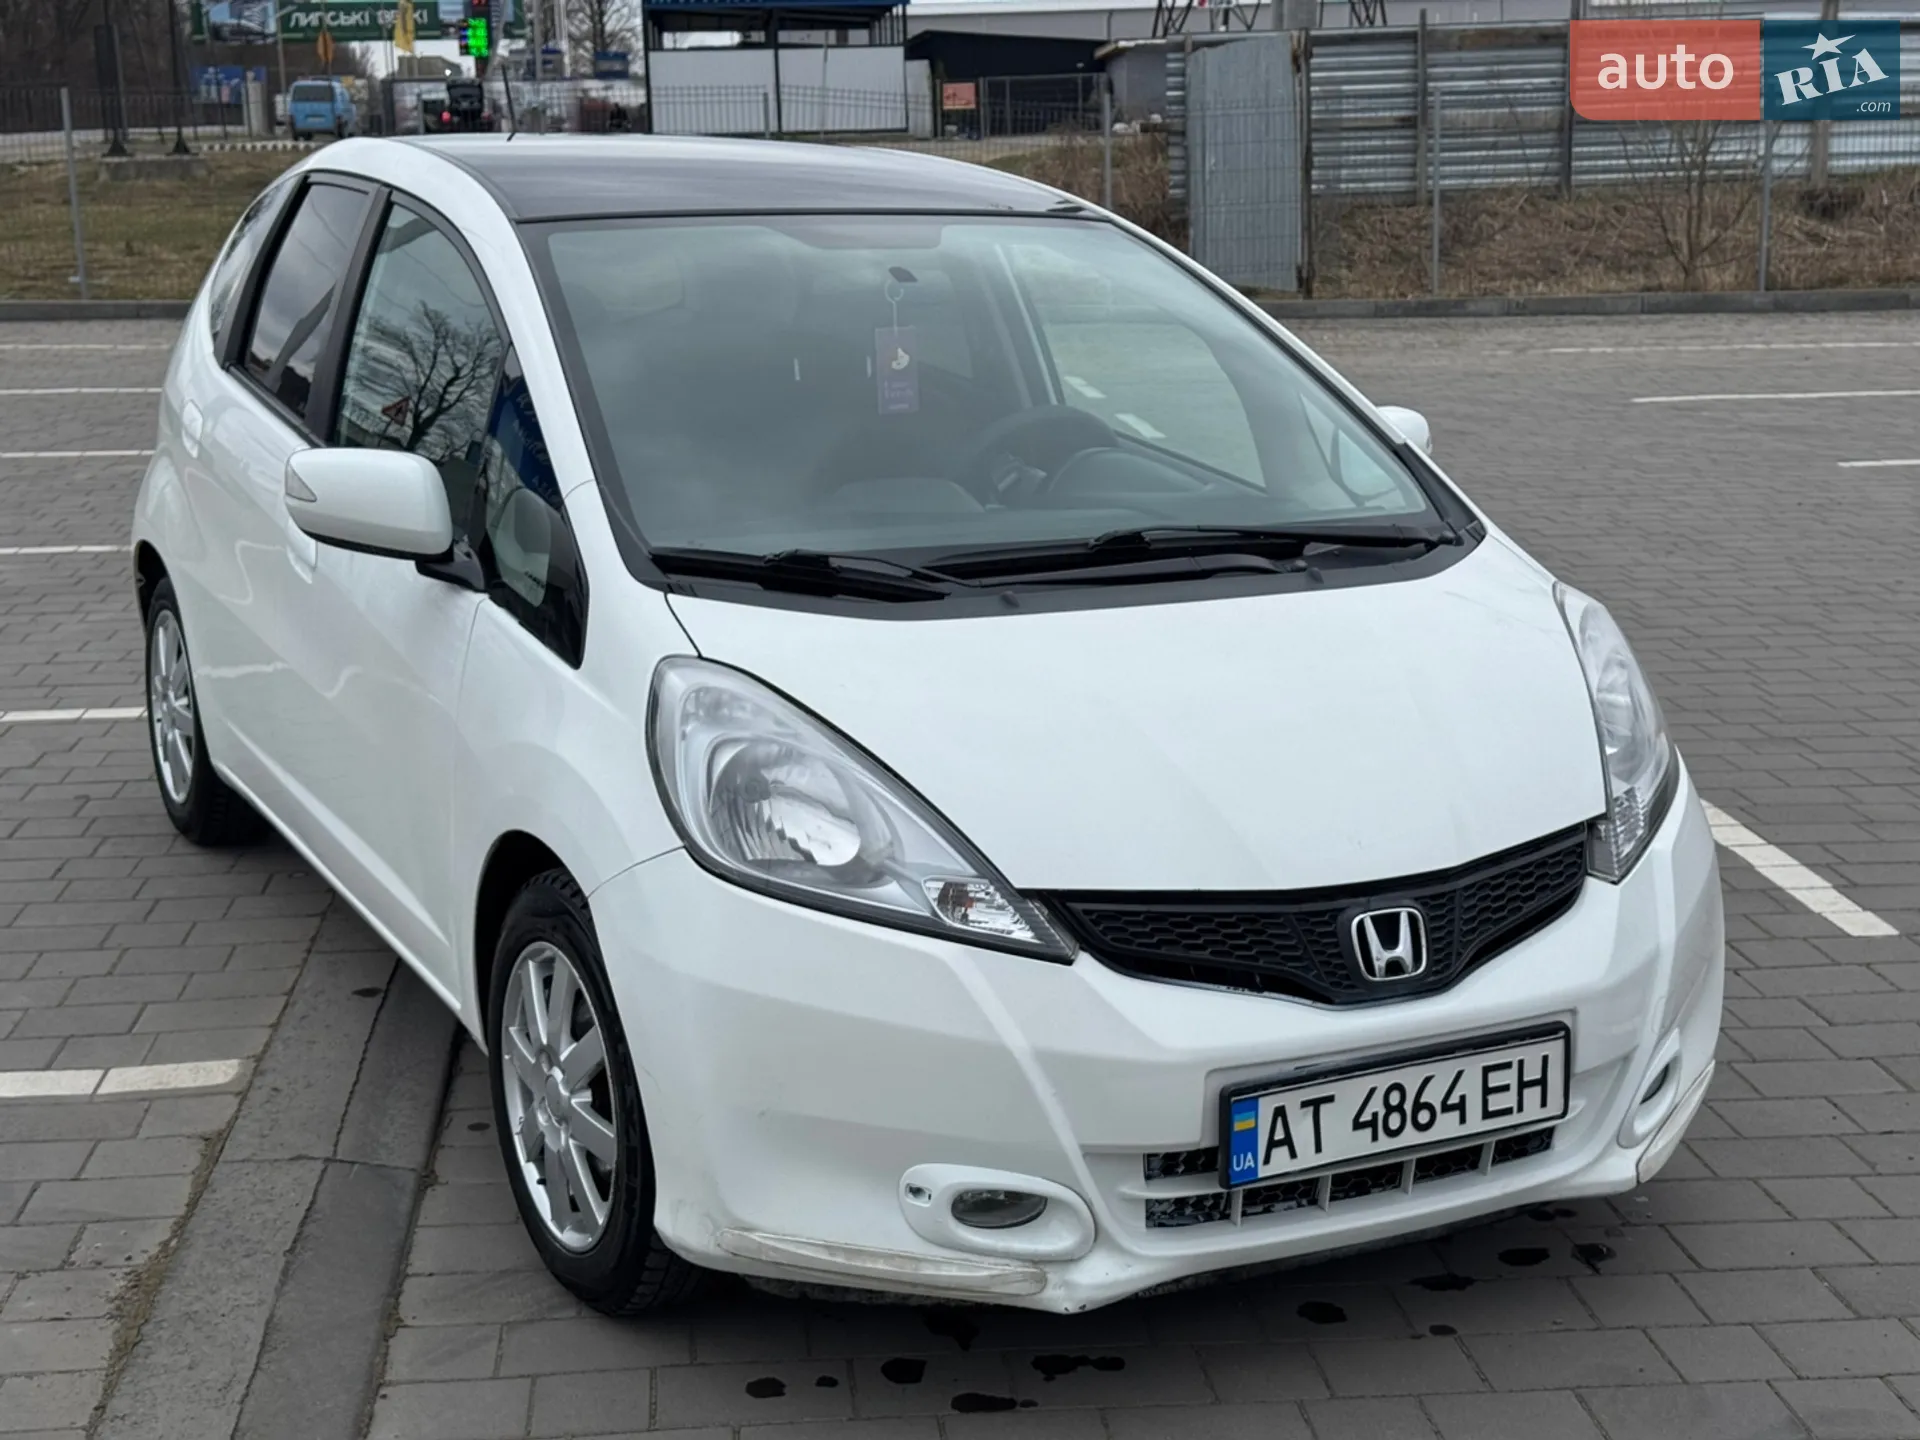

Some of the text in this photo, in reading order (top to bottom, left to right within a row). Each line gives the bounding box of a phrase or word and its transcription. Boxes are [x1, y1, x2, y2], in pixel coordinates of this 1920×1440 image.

[1262, 1054, 1550, 1166] AT 4864 EH
[1232, 1151, 1256, 1172] UA
